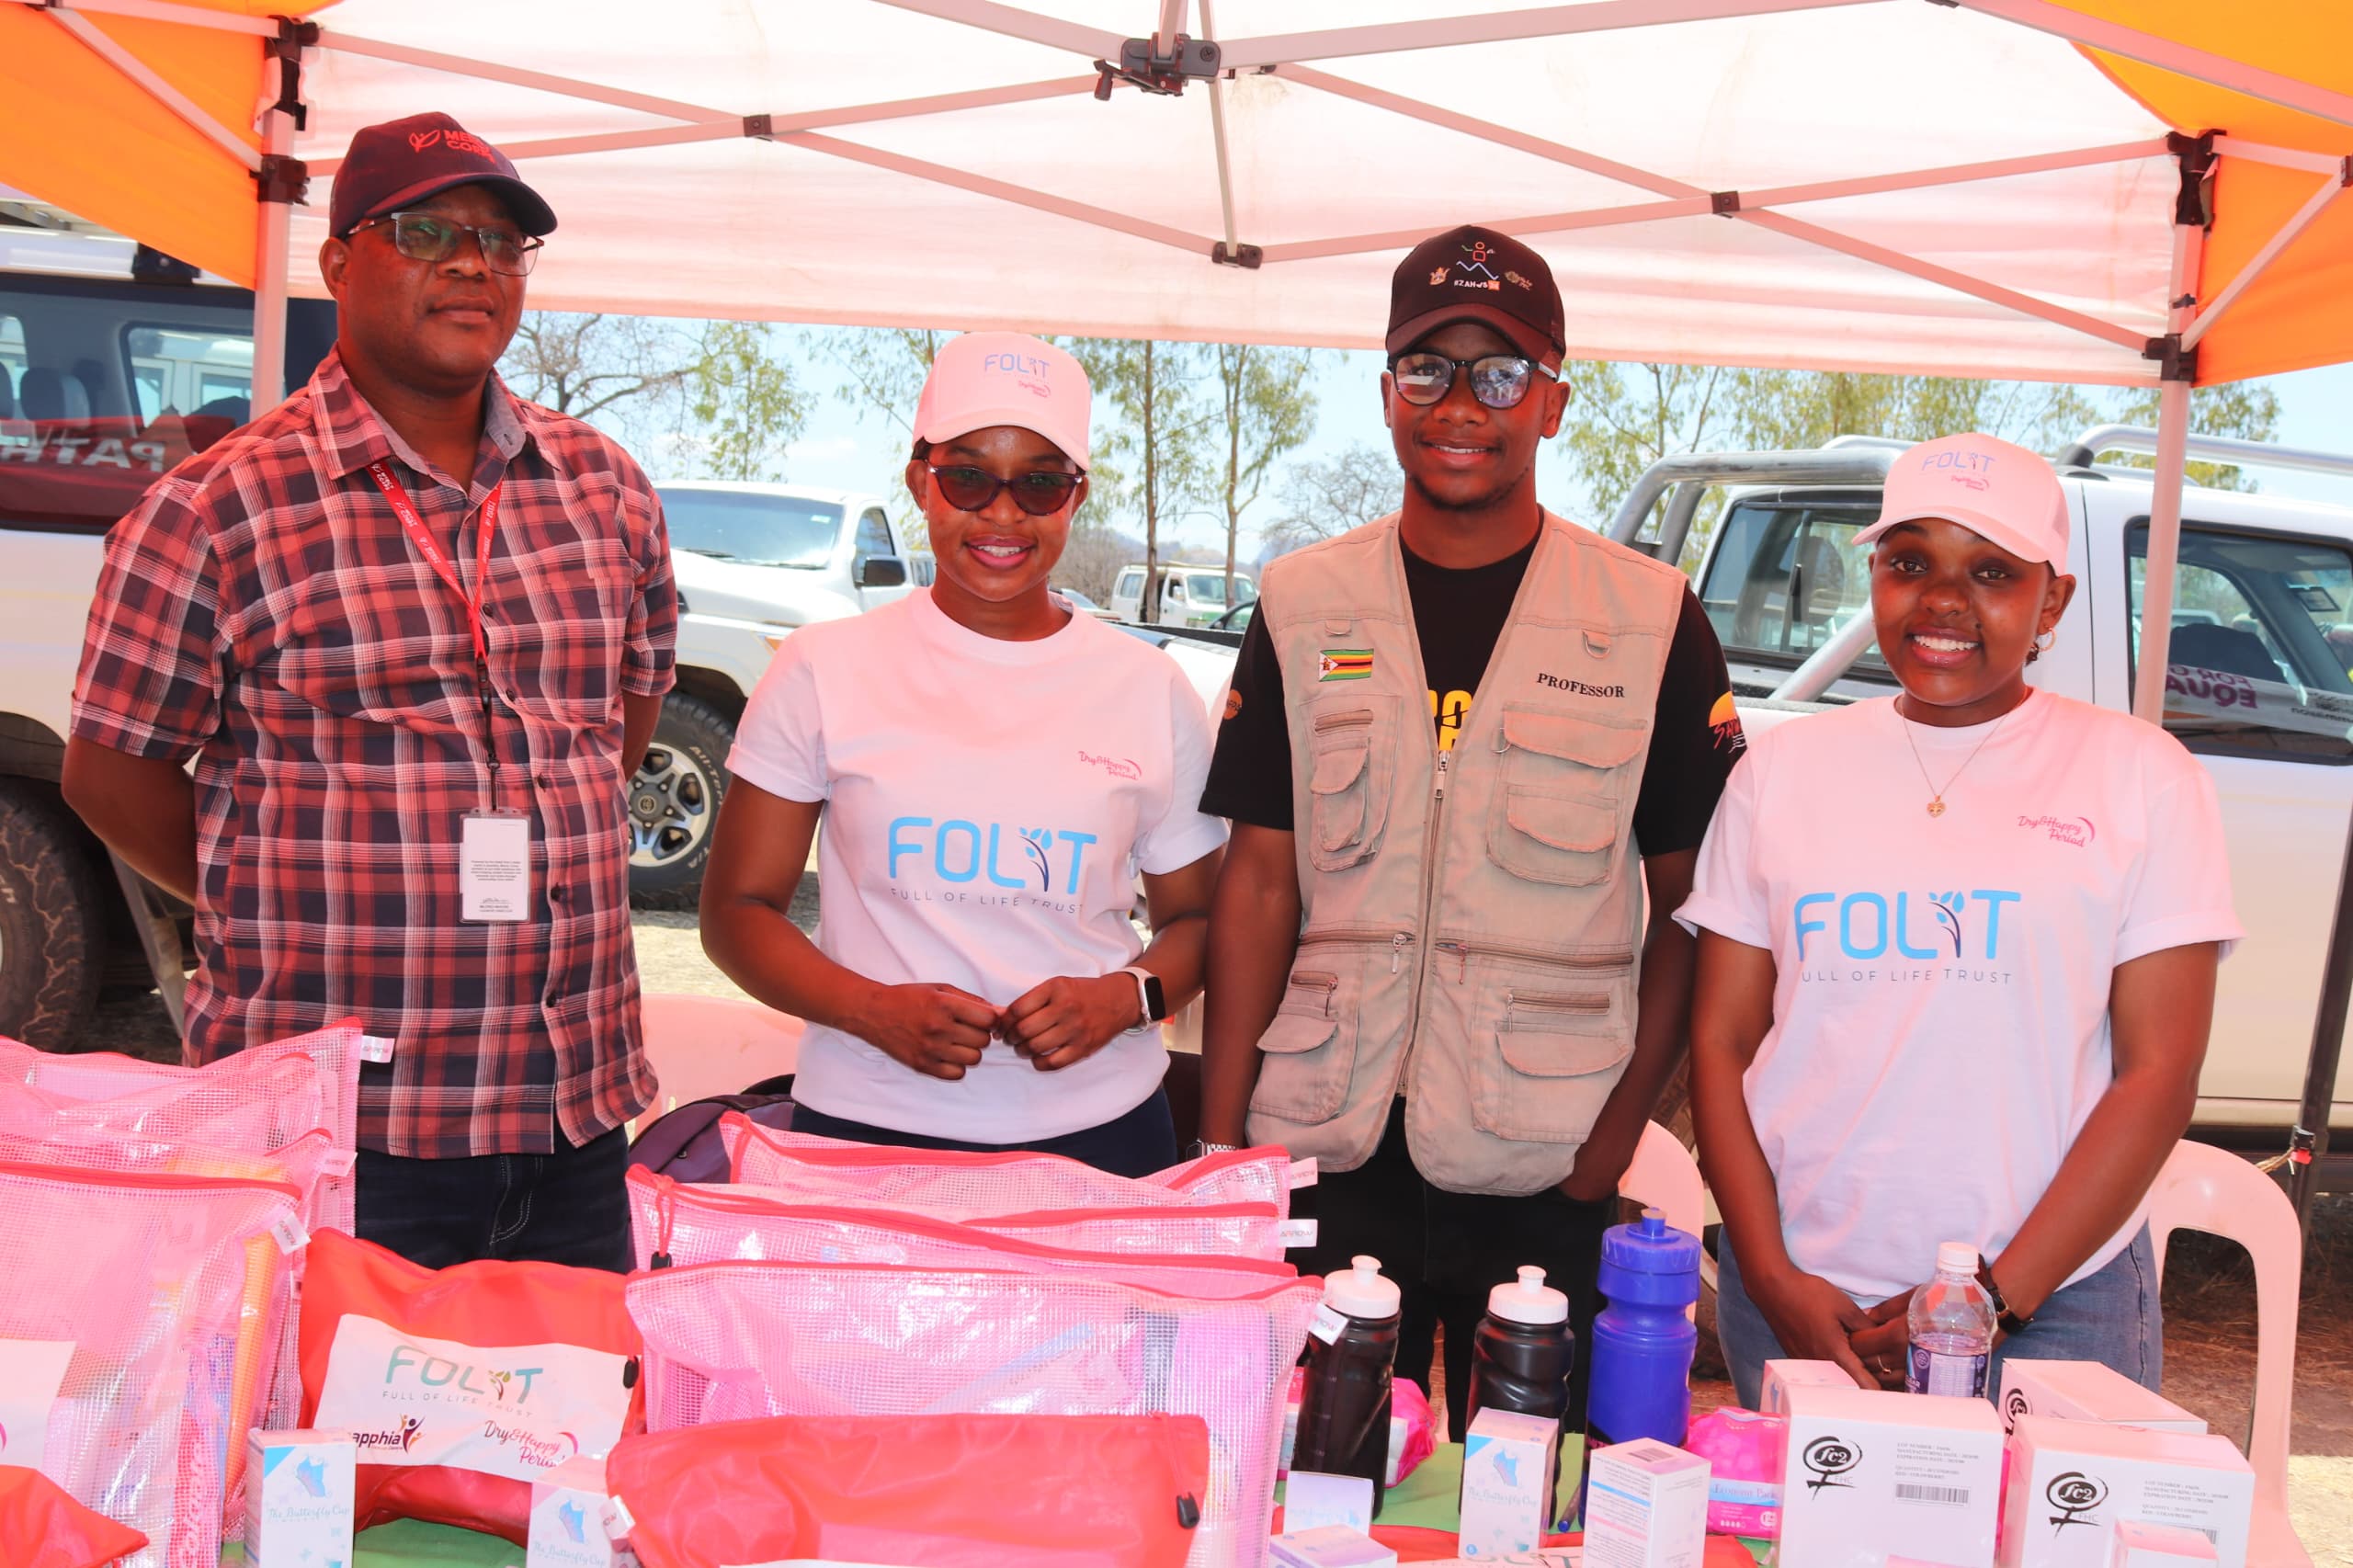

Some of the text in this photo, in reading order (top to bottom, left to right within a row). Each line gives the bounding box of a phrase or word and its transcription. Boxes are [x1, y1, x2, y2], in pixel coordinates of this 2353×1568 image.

[1536, 672, 1626, 699] PROFESSOR
[2048, 828, 2086, 847] Period
[944, 892, 969, 903] OF
[980, 896, 1020, 907] LIFE
[1802, 968, 2013, 985] ULL OF LIFE TRUST
[382, 1390, 415, 1401] FULL
[423, 1392, 440, 1402] OF
[447, 1395, 480, 1405] LIFE
[353, 1429, 403, 1449] apphia
[484, 1419, 562, 1455] Dry&Happy
[1816, 1446, 1849, 1463] fc2
[2060, 1483, 2094, 1501] fc2
